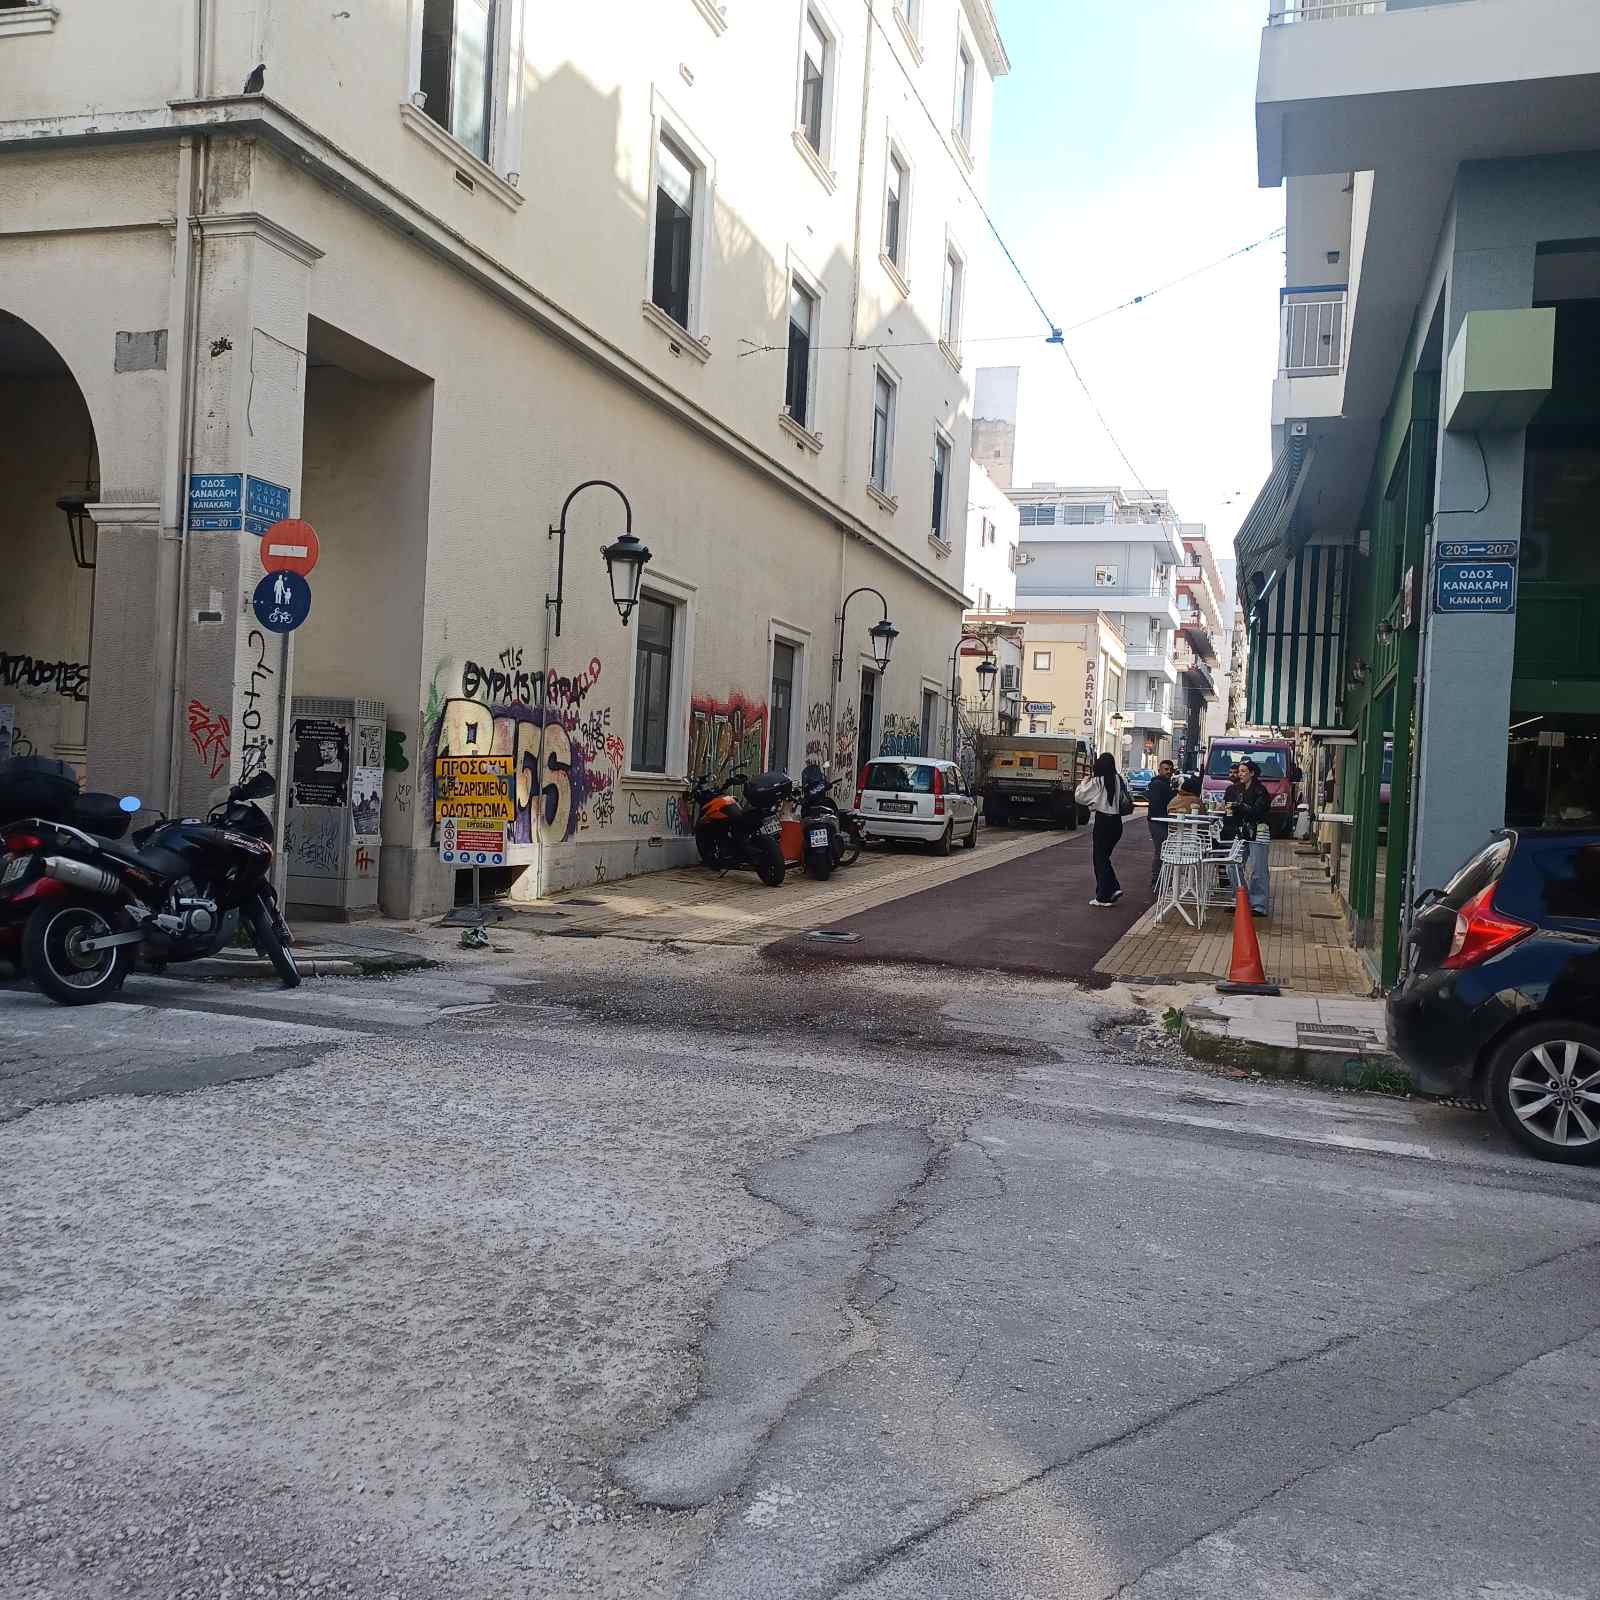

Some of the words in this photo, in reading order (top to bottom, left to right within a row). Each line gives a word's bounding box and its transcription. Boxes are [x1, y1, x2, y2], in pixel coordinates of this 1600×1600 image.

[200, 479, 226, 488] ΟΔΟΣ
[193, 500, 232, 509] KANAKARI
[191, 519, 205, 527] 201
[218, 519, 232, 527] 201
[1446, 544, 1468, 555] 203
[1487, 544, 1509, 555] 207
[1459, 569, 1494, 579] ΟΔΟΣ
[1443, 580, 1509, 590] ΚΑΝΑΚΑΡΗ
[1449, 596, 1502, 605] KANAKARI
[1083, 660, 1096, 726] PARKING
[440, 802, 509, 818] ΟΔΟΣΤΡΩΜΑ
